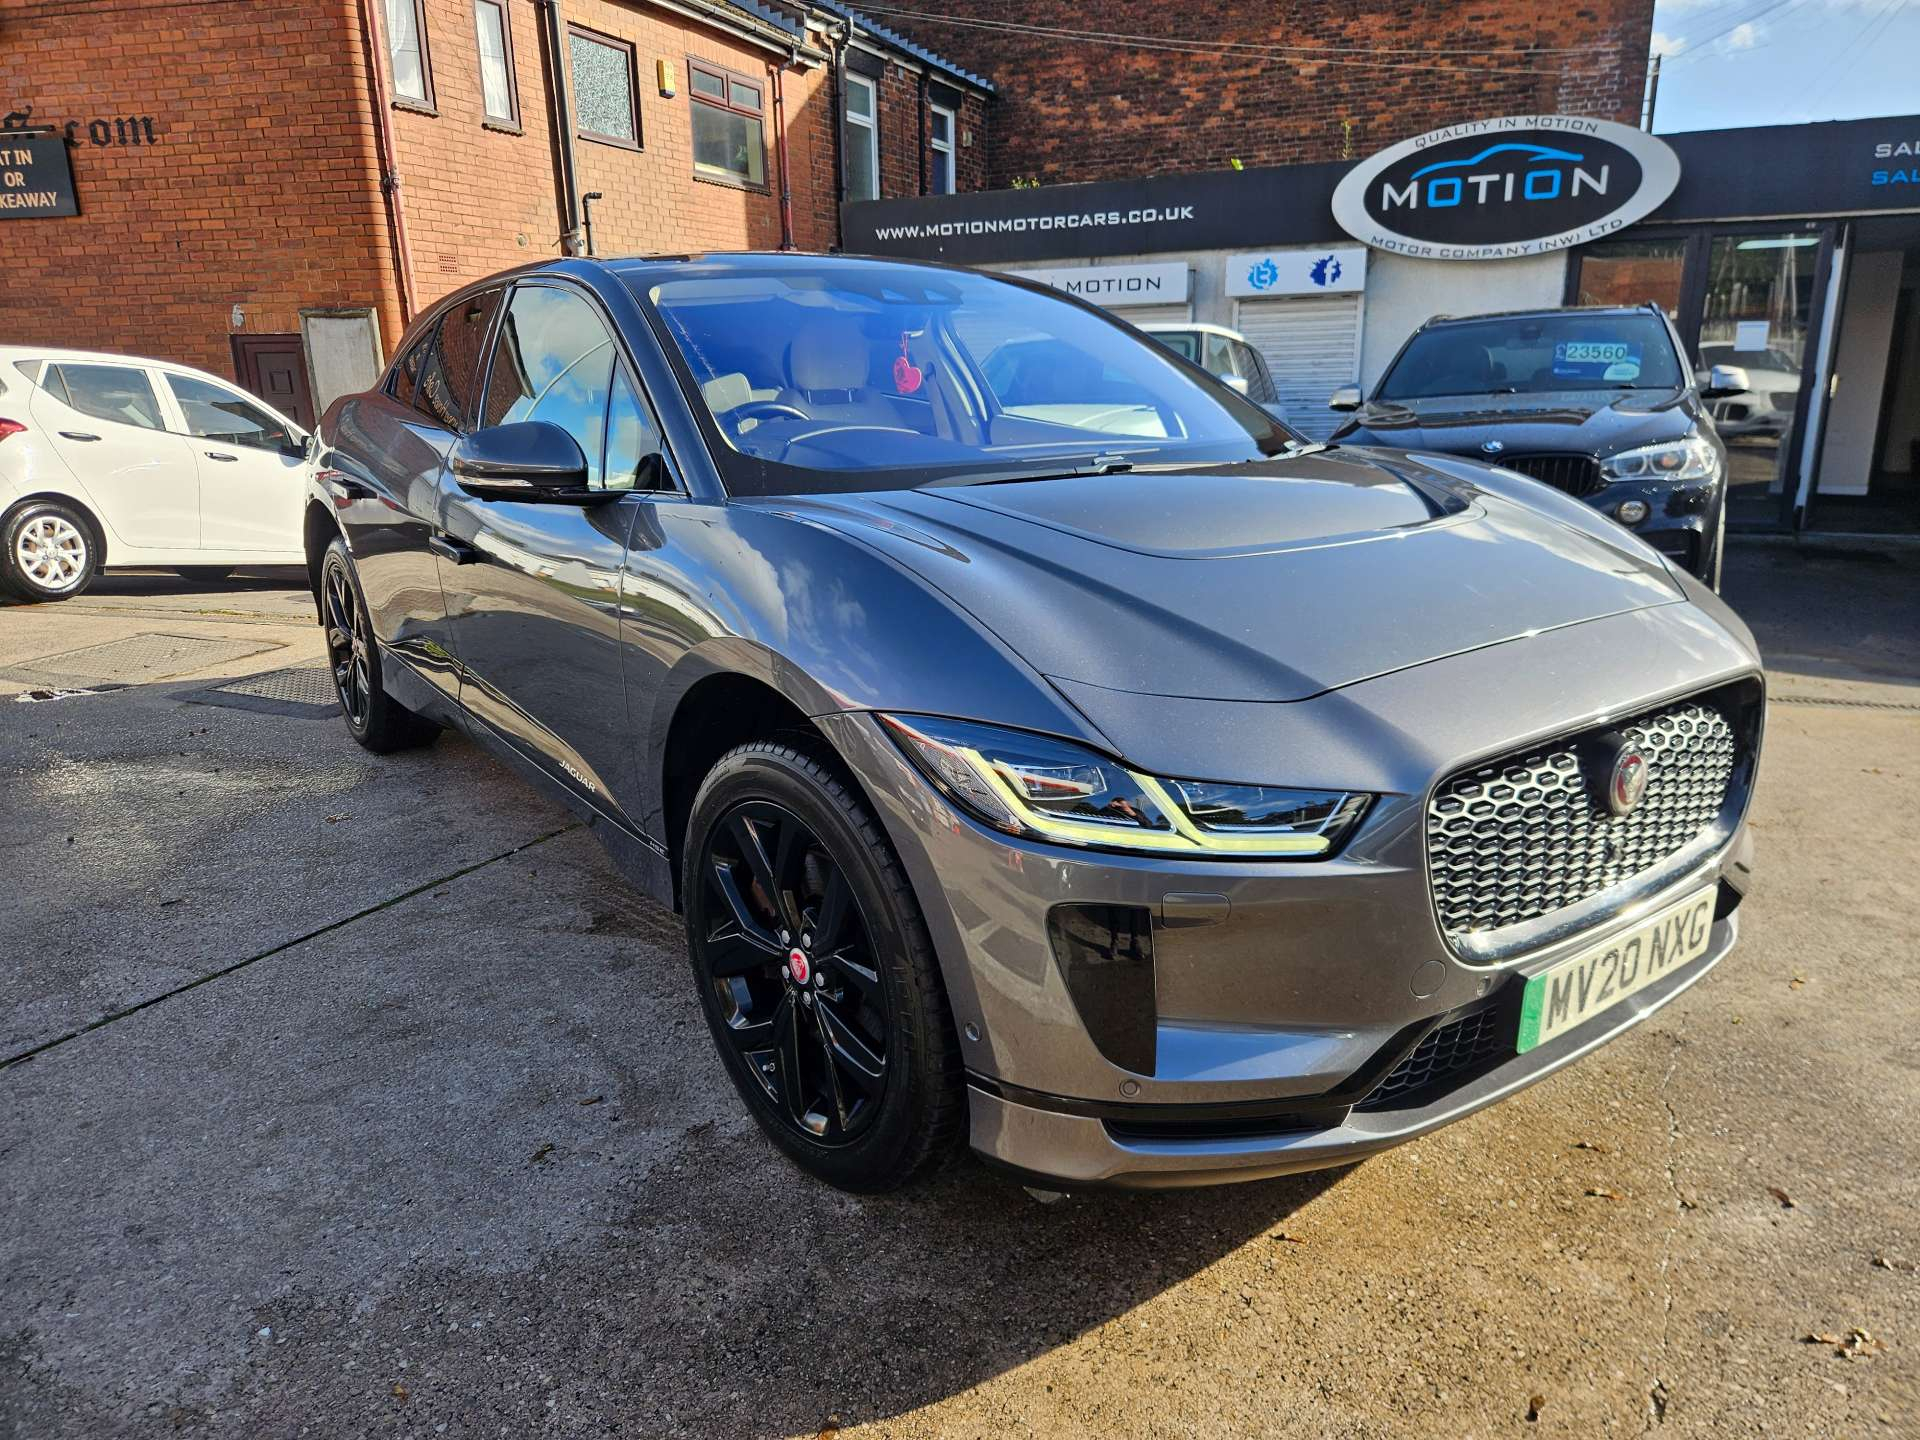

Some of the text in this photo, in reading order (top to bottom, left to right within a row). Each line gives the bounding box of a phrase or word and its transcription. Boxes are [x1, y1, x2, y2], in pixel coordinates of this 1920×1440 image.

[1414, 116, 1599, 149] QUALITY IN MOTION
[14, 149, 33, 165] IN
[4, 172, 26, 187] OR
[1382, 165, 1609, 211] MOTION
[875, 205, 1194, 241] WWW.MOTIONMOTORCARS.CO.UK
[1371, 218, 1624, 260] MOTOR COMPANY (NW) LTD
[1066, 277, 1161, 295] MOTION
[558, 760, 596, 793] JAGUAR
[1546, 901, 1708, 1030] MV20 NXG
